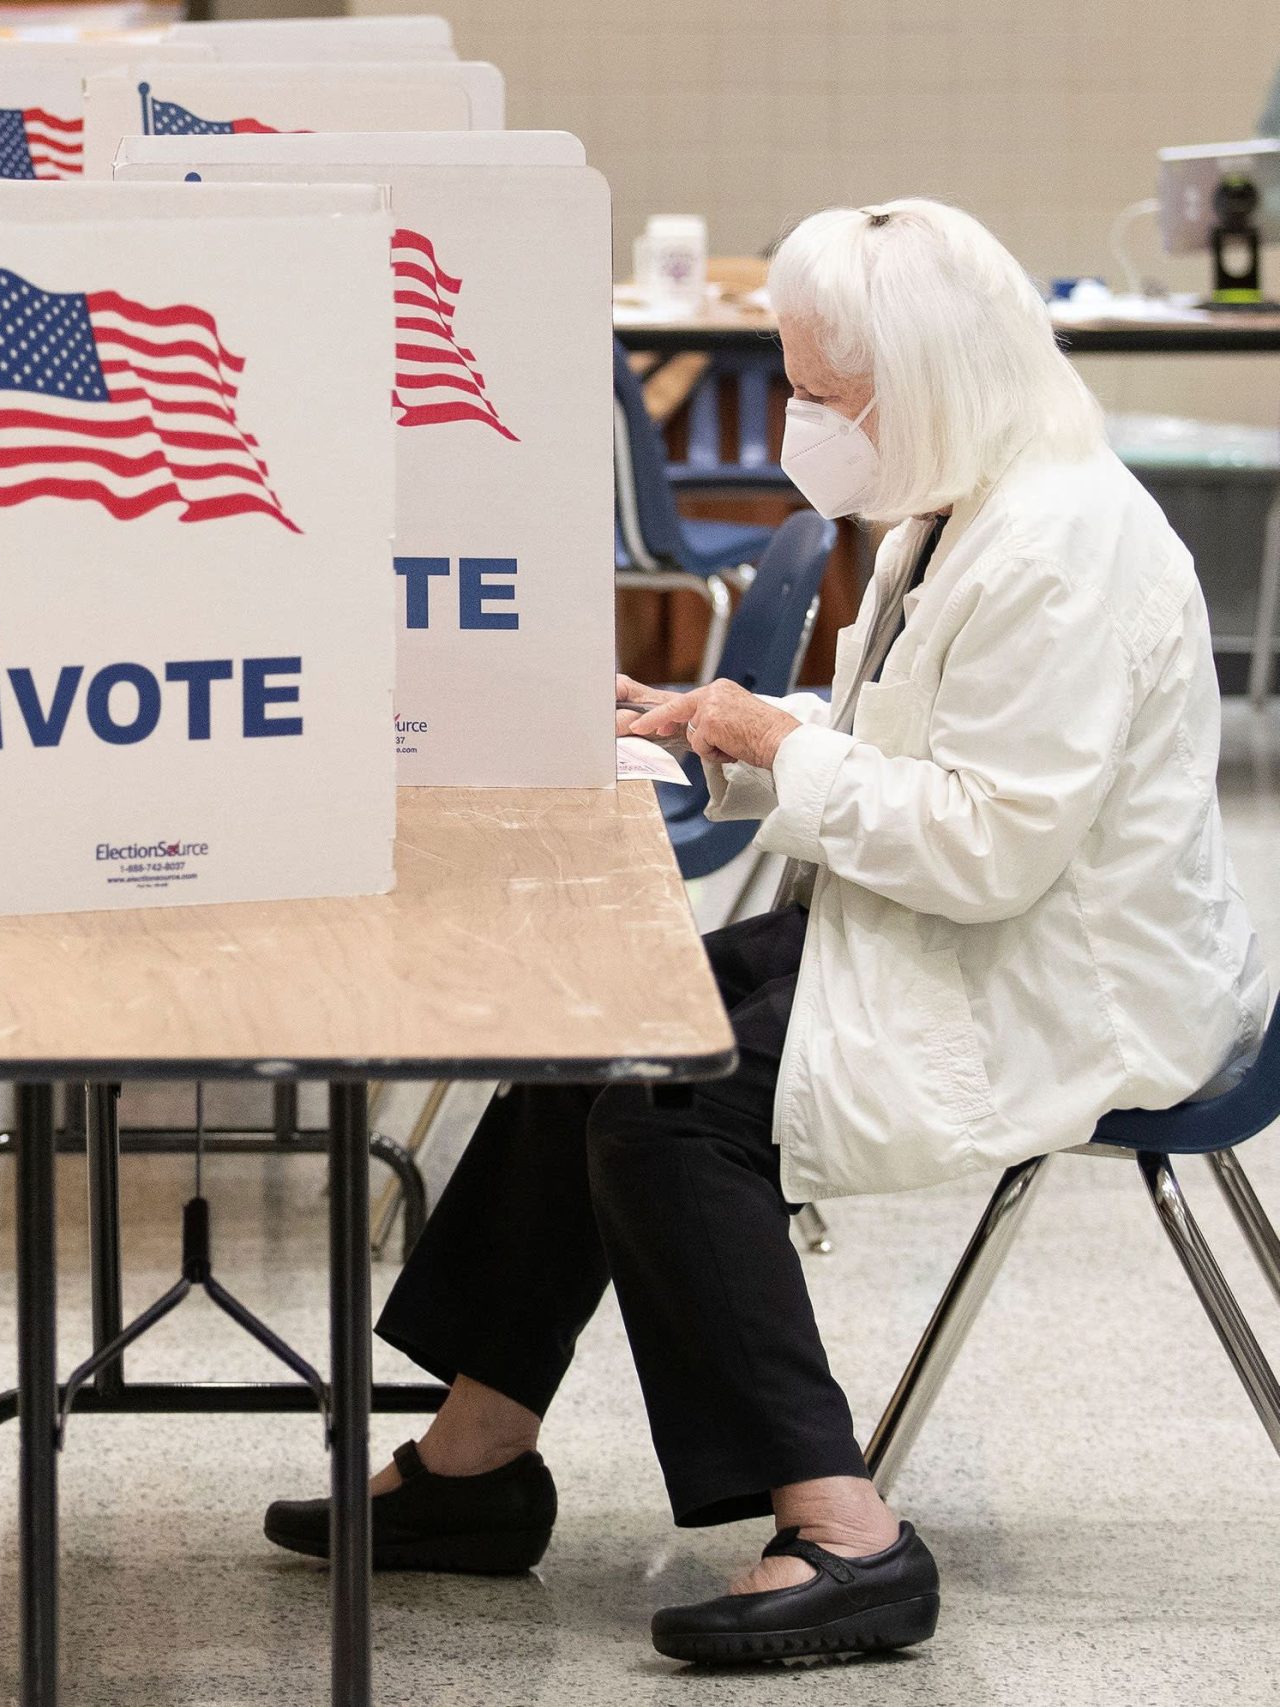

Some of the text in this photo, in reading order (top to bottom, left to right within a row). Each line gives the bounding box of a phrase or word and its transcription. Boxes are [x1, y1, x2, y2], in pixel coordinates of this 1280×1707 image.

[393, 557, 519, 630] TE
[6, 656, 303, 747] VOTE
[394, 720, 428, 733] urce
[95, 840, 209, 861] ElectionSource
